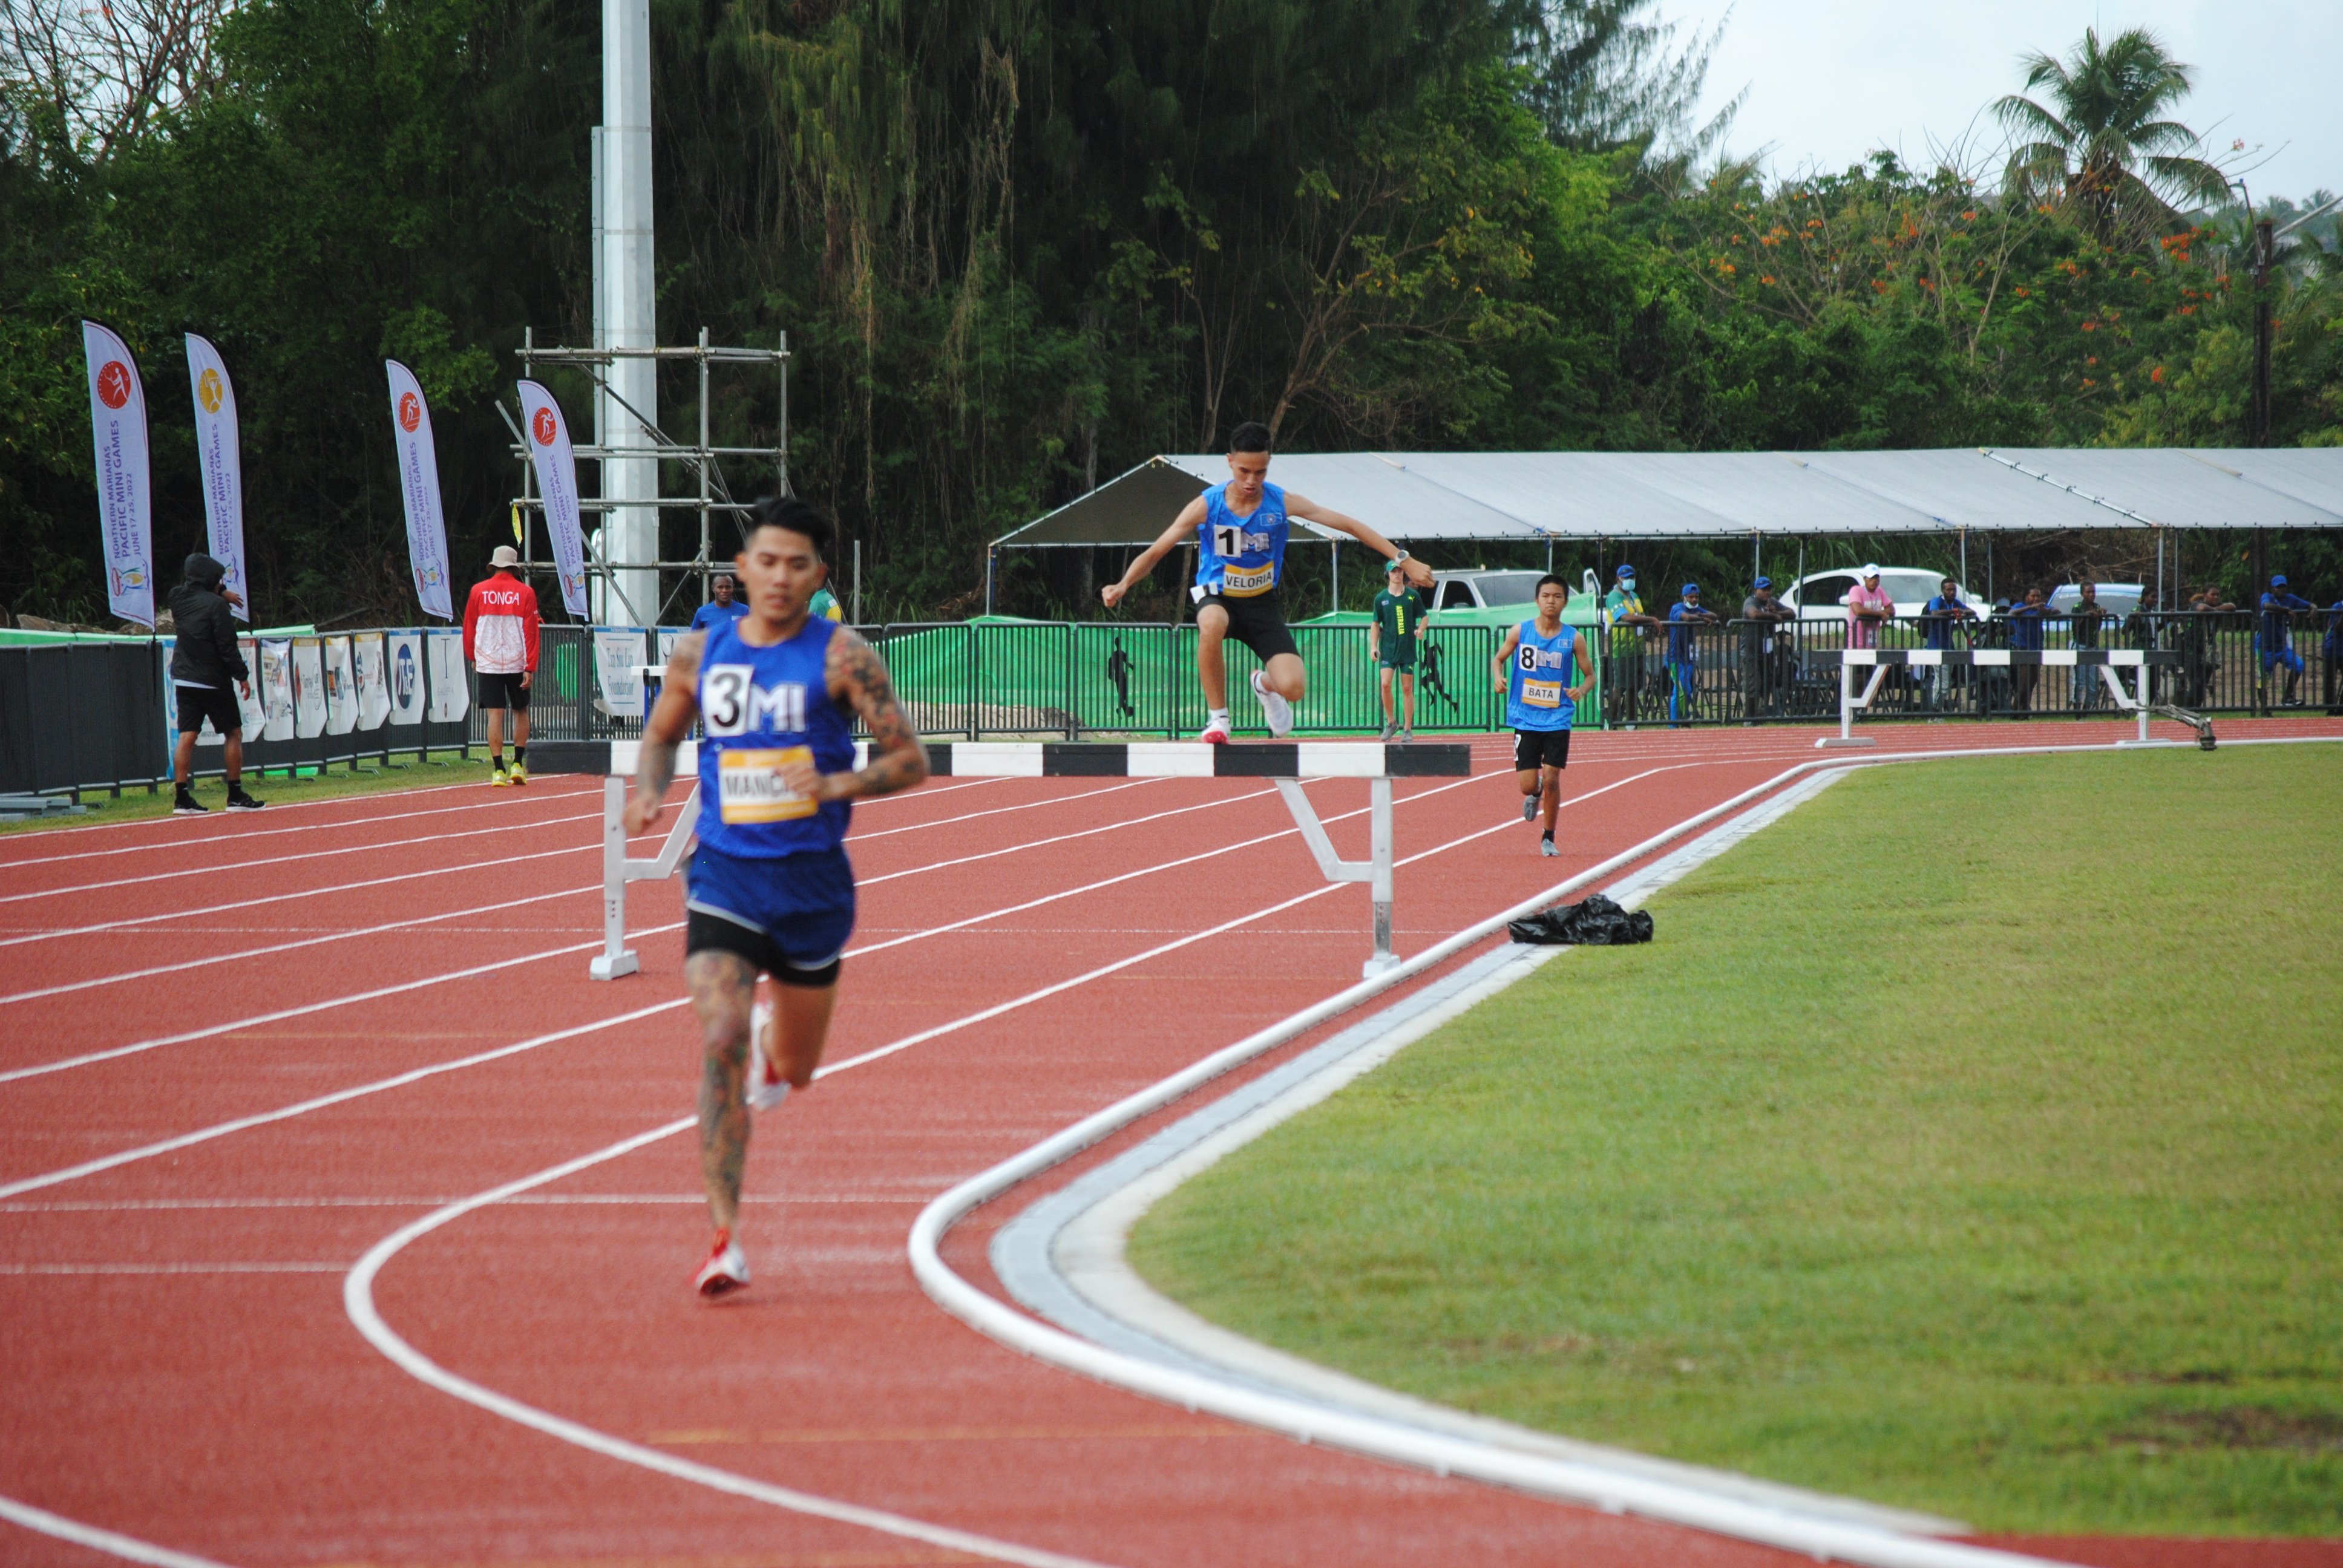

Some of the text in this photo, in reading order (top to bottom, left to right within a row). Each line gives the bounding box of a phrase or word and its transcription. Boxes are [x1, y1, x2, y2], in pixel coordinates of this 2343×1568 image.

[411, 442, 421, 483] GAMES
[549, 454, 562, 495] GAMES
[104, 446, 120, 558] NORTHERN MARIANAS
[111, 420, 130, 557] PACIFIC MINI GAMES
[209, 448, 223, 554] NORTHERN MARIANAS
[212, 423, 229, 552] PACIFIC MINI GAMES
[417, 486, 425, 514] MINI
[408, 465, 424, 560] NORTHERN MARIANAS
[549, 477, 571, 567] NORTHERN MARIANAS
[558, 497, 568, 521] MINI
[131, 531, 141, 555] JUNE
[564, 523, 576, 564] PACIFIC
[1219, 529, 1234, 555] 1
[1226, 572, 1272, 587] VELORIA
[482, 590, 520, 606] TONGA
[1396, 606, 1404, 635] AUSTRALIA
[1522, 647, 1534, 669] 8
[608, 676, 634, 695] Foundation
[713, 673, 741, 727] 3
[1529, 687, 1554, 699] BATA
